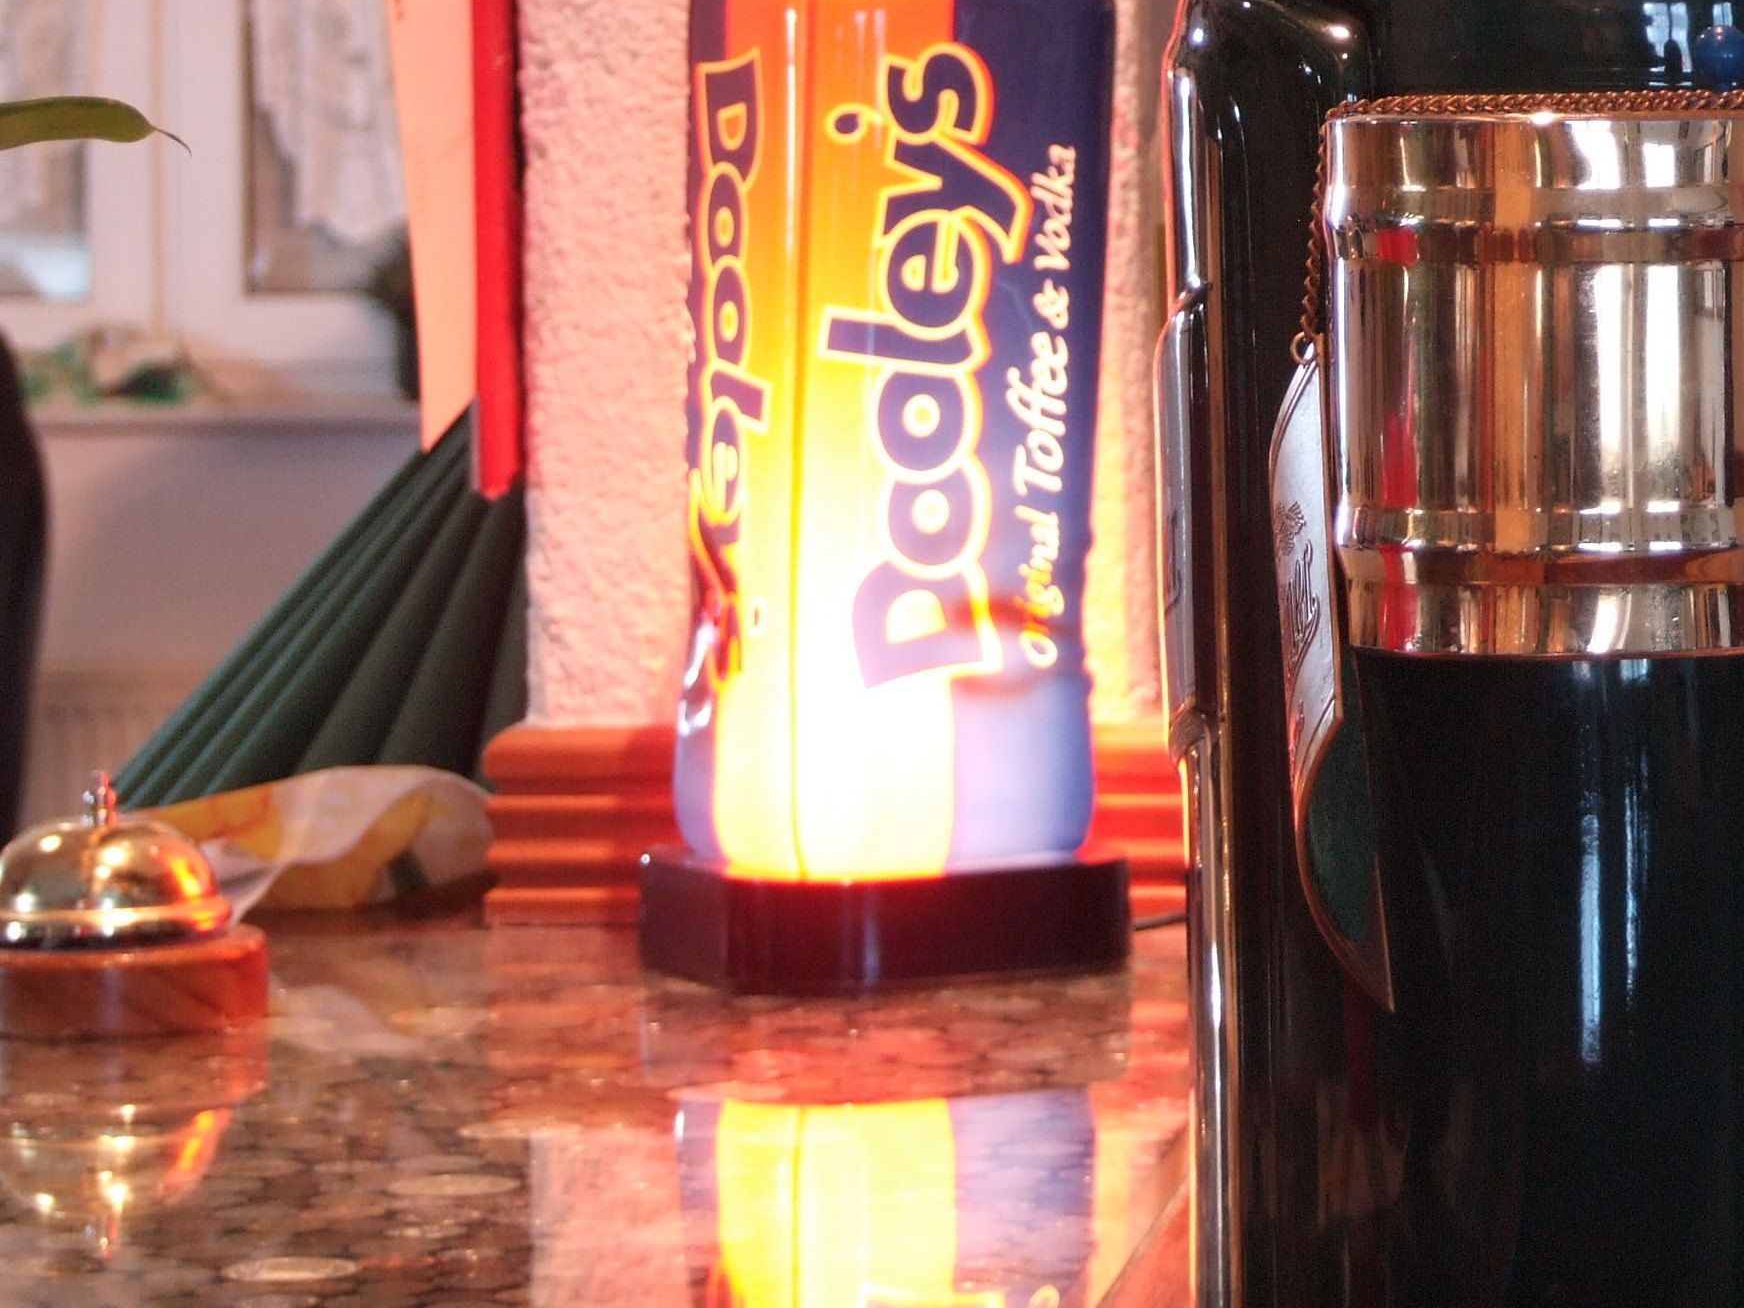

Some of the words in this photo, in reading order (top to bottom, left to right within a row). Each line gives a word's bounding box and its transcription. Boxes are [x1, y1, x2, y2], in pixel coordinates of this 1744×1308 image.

[1030, 143, 1077, 271] Vodka
[818, 42, 1032, 688] Dooley's
[1033, 278, 1069, 330] &
[1006, 331, 1068, 495] Toffee
[1020, 503, 1064, 668] Original
